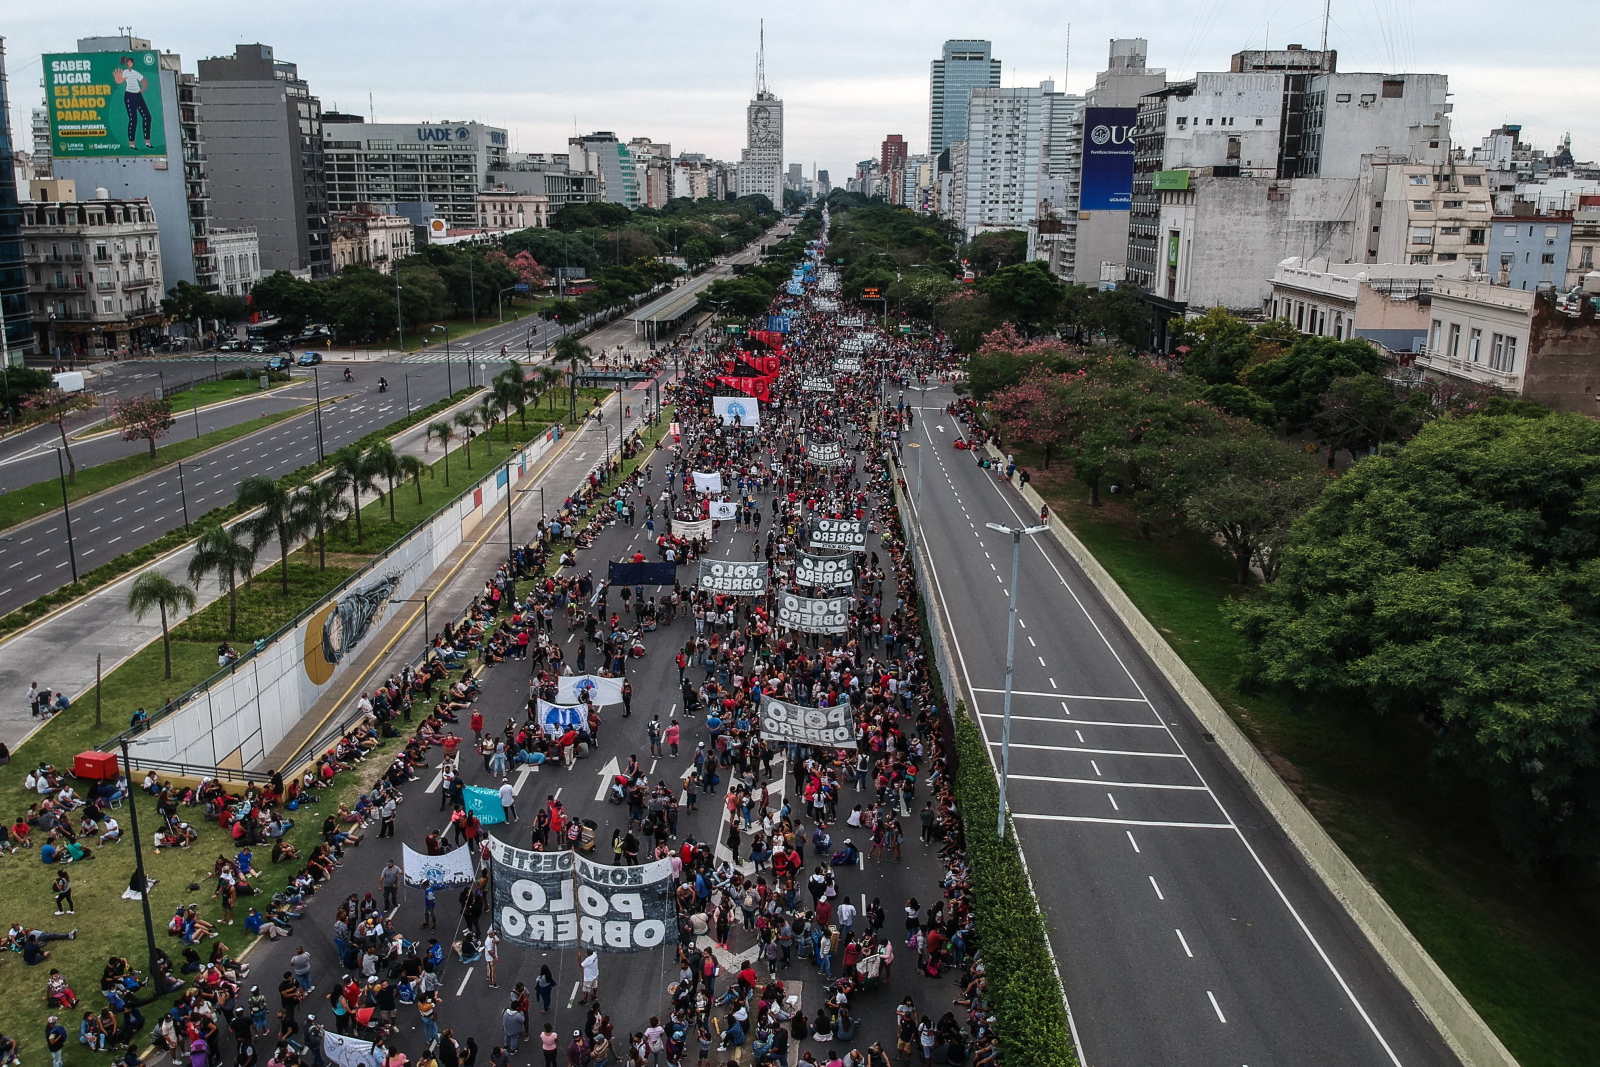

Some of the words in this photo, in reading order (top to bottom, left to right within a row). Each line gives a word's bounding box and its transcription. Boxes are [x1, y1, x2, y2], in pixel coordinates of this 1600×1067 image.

[52, 60, 91, 72] SABER
[54, 73, 91, 84] JUGAR
[1202, 74, 1232, 92] RADIO
[1236, 74, 1280, 92] CULTURA
[54, 86, 69, 96] ES
[72, 84, 111, 96] SABER
[56, 96, 106, 108] CUÁNDO
[56, 110, 101, 121] PARAR.
[418, 128, 452, 141] UADE
